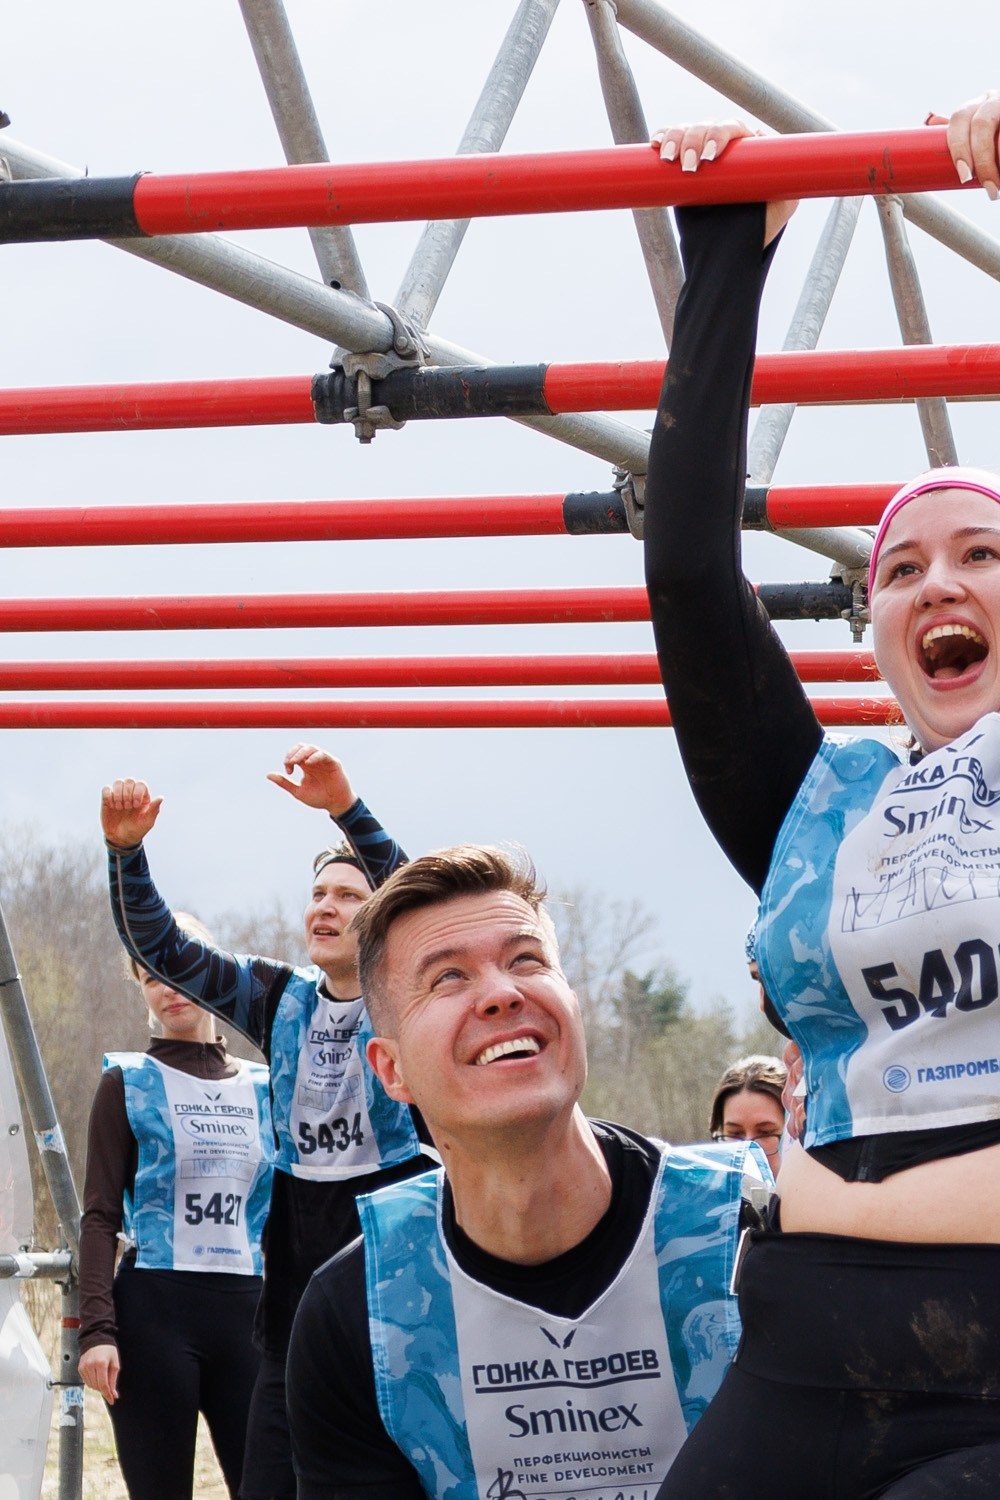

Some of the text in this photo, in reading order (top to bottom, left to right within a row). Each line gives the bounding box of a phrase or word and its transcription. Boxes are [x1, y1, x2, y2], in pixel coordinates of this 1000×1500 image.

[174, 1104, 254, 1116] ГОНКА ГЕРОЕВ
[190, 1119, 248, 1137] Sminex
[298, 1112, 364, 1155] 5434
[185, 1192, 242, 1227] 5427
[473, 1349, 659, 1385] ГОНКА ГЕРОЕВ
[505, 1400, 643, 1438] Sminex
[513, 1446, 651, 1467] ПЕРФЕКЦИОНИСТЫ
[518, 1463, 654, 1484] FINE DEVELOPMENT
